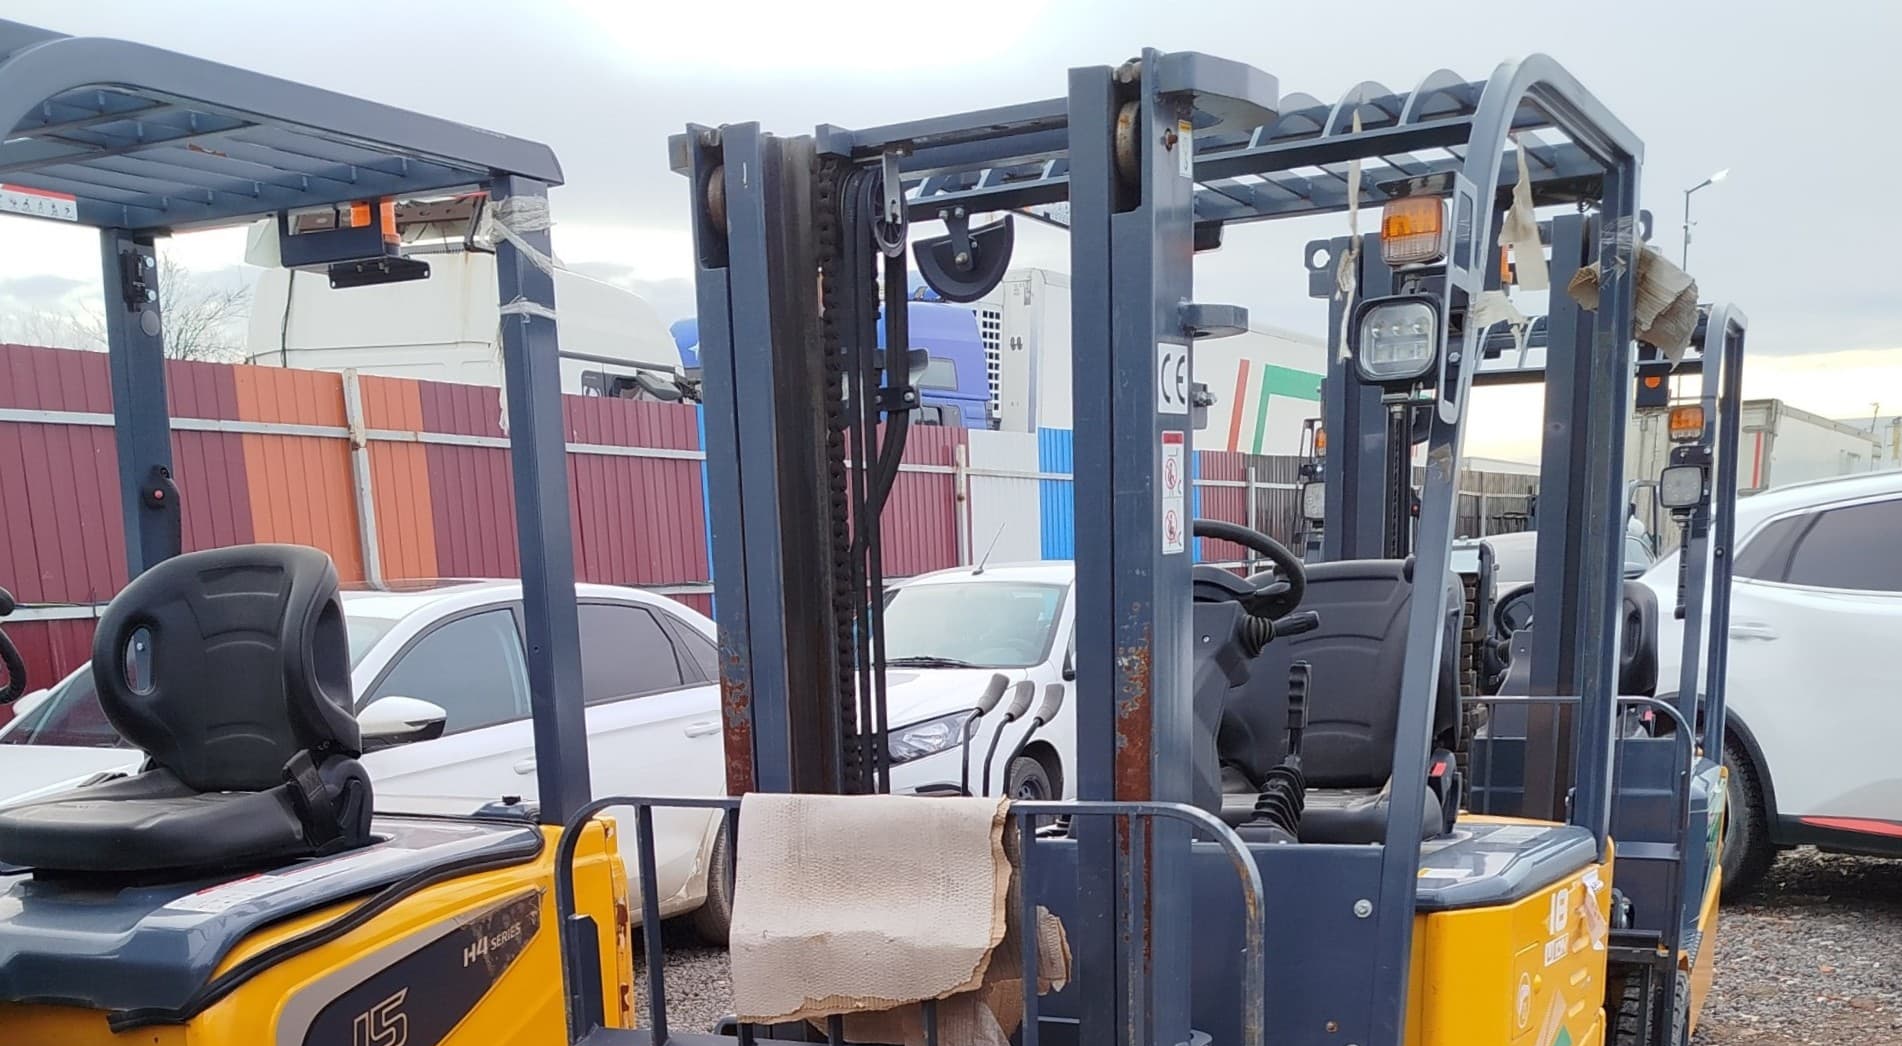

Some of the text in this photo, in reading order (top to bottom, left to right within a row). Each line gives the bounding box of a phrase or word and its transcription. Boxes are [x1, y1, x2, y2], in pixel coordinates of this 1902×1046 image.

[1161, 352, 1186, 405] CE
[463, 922, 522, 967] H4 SERIES
